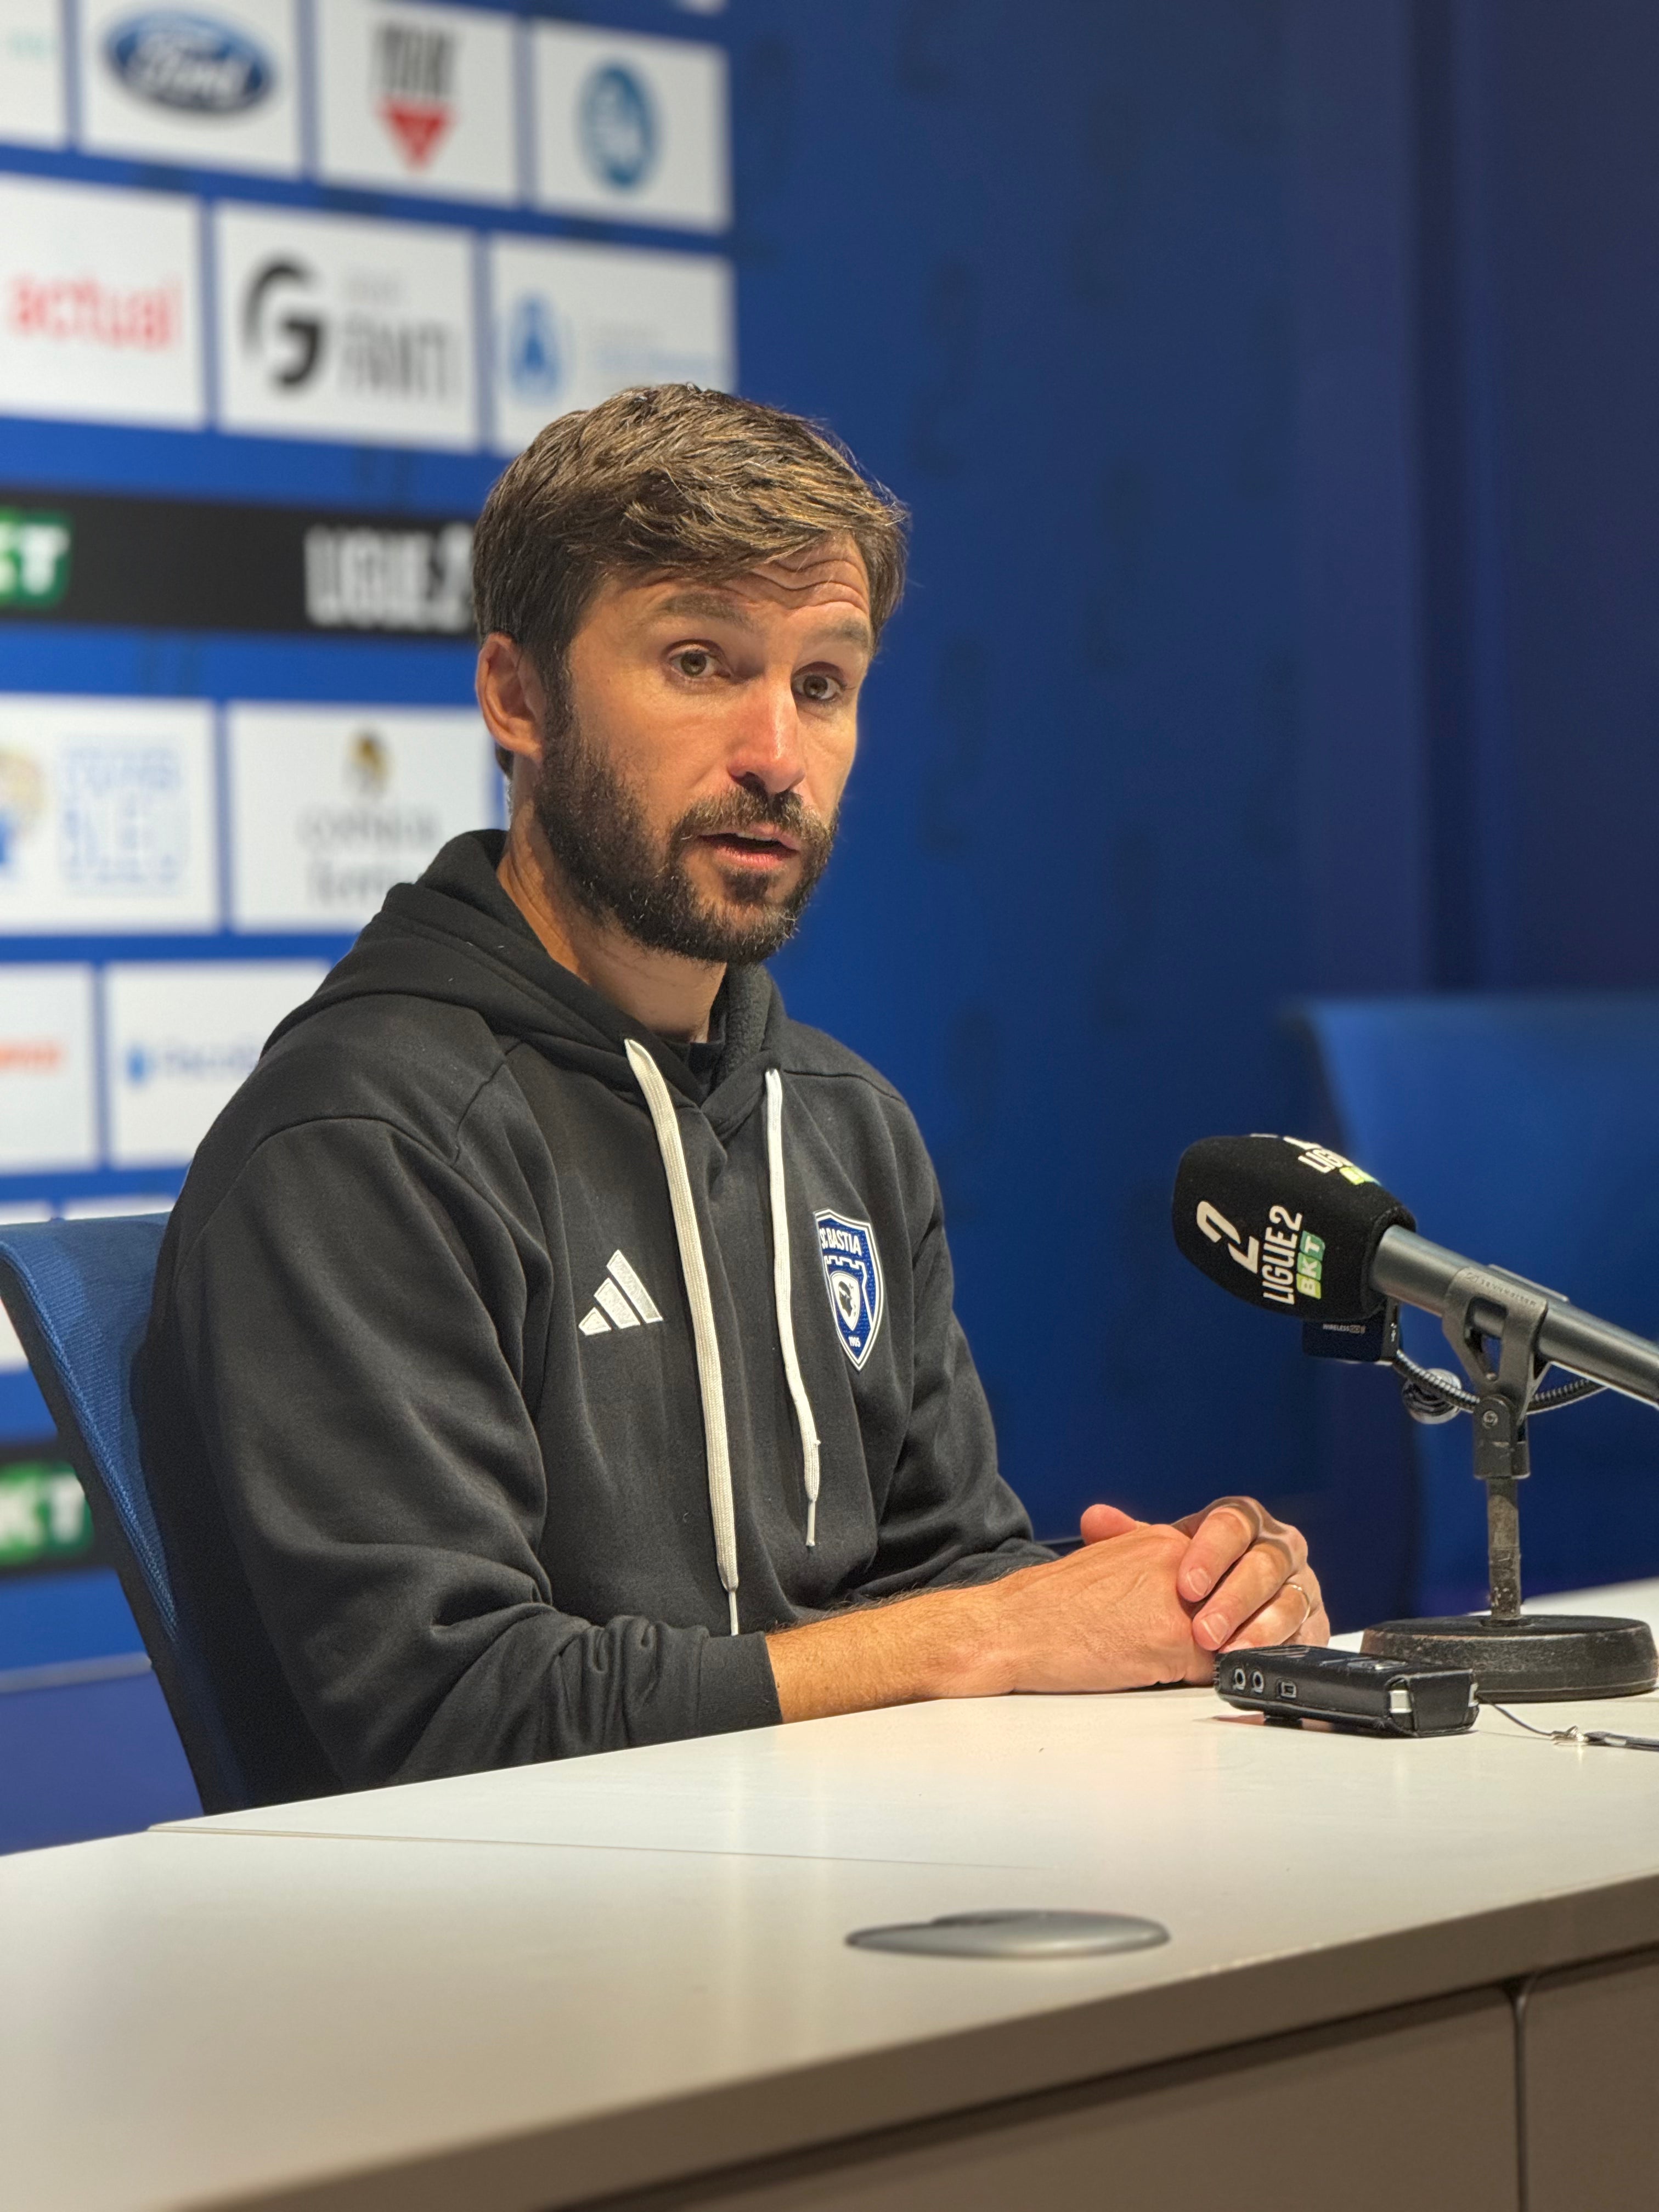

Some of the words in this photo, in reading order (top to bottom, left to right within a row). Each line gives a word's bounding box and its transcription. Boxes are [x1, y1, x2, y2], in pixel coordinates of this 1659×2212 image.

[11, 274, 181, 351] actual
[826, 1228, 862, 1256] BASTIA
[1269, 1205, 1302, 1231] 2
[1262, 1227, 1299, 1305] LIGUE
[1300, 1236, 1321, 1296] BKT
